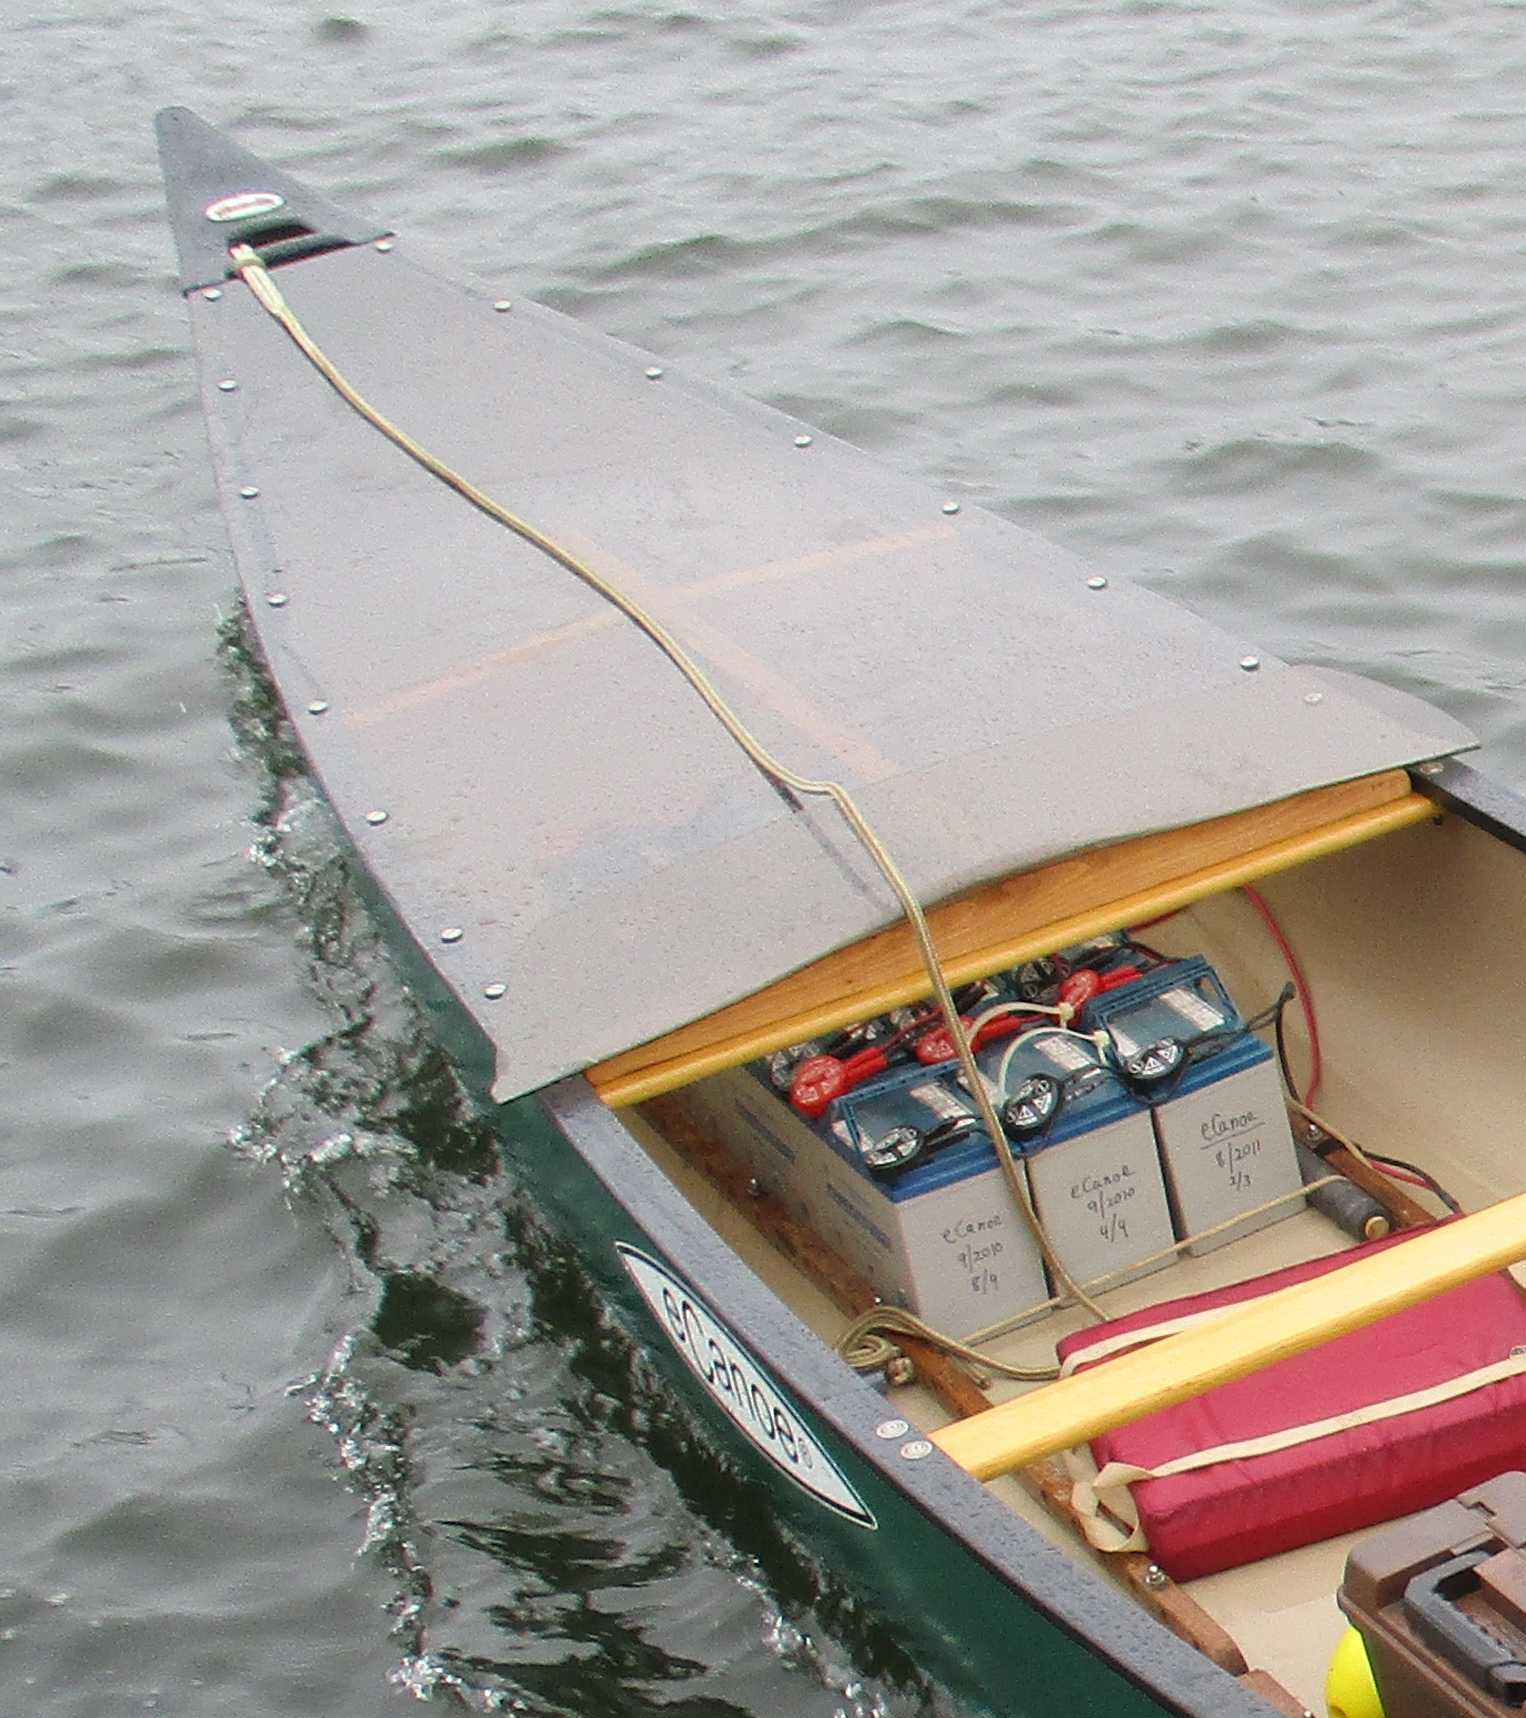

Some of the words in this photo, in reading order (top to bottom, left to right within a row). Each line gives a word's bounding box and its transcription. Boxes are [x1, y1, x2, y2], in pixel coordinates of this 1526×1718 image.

[1201, 1111, 1257, 1141] eCanoe
[1216, 1140, 1261, 1174] 8/2011
[1071, 1165, 1136, 1199] eCanoe
[1087, 1187, 1136, 1219] 9/2010
[943, 1215, 1002, 1244] eCanoe
[1100, 1213, 1129, 1242] 4/4
